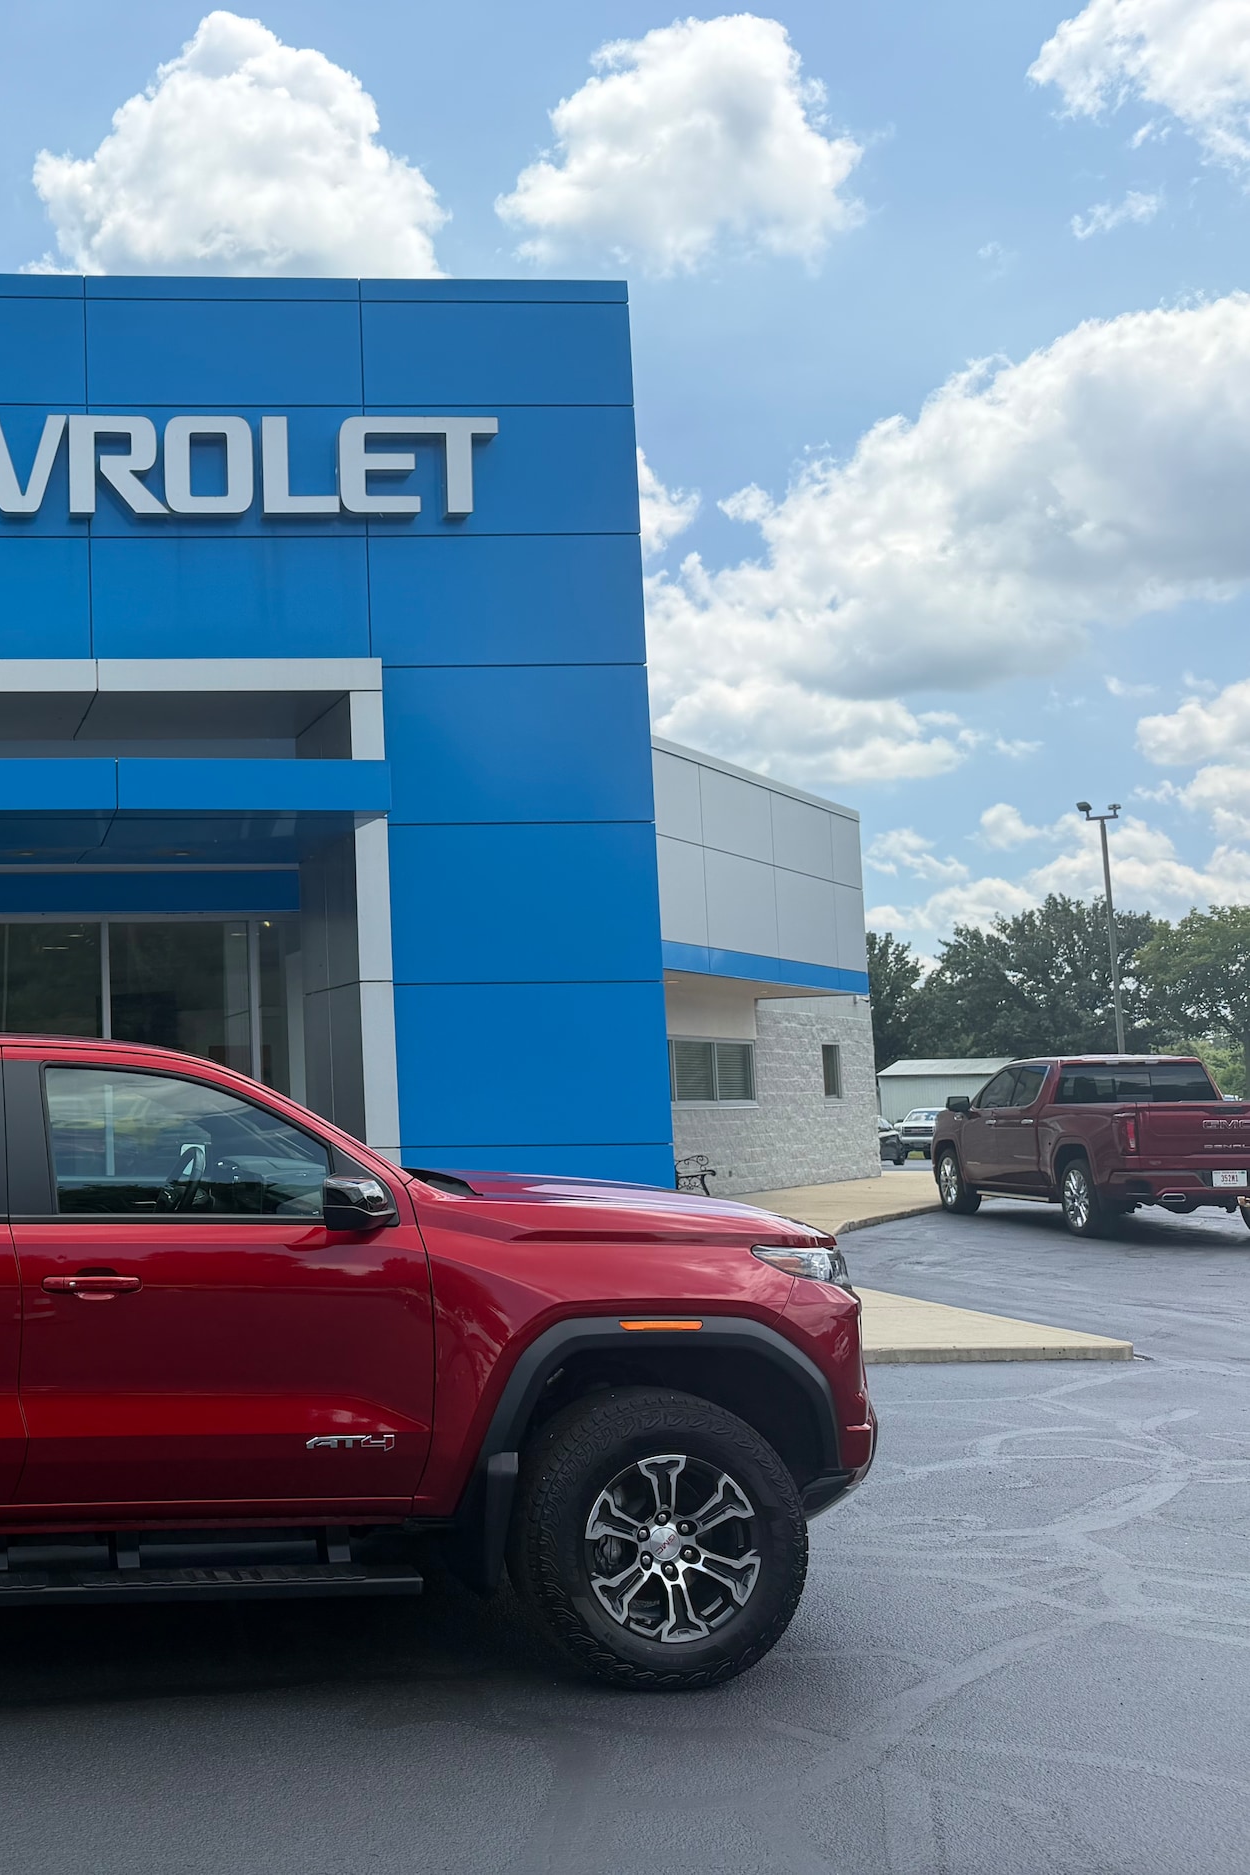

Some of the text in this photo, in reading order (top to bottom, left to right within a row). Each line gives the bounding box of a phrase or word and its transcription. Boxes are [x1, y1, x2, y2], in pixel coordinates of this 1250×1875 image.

[1203, 1119, 1250, 1130] GMC
[306, 1435, 395, 1452] AT4
[655, 1534, 676, 1555] GMC
